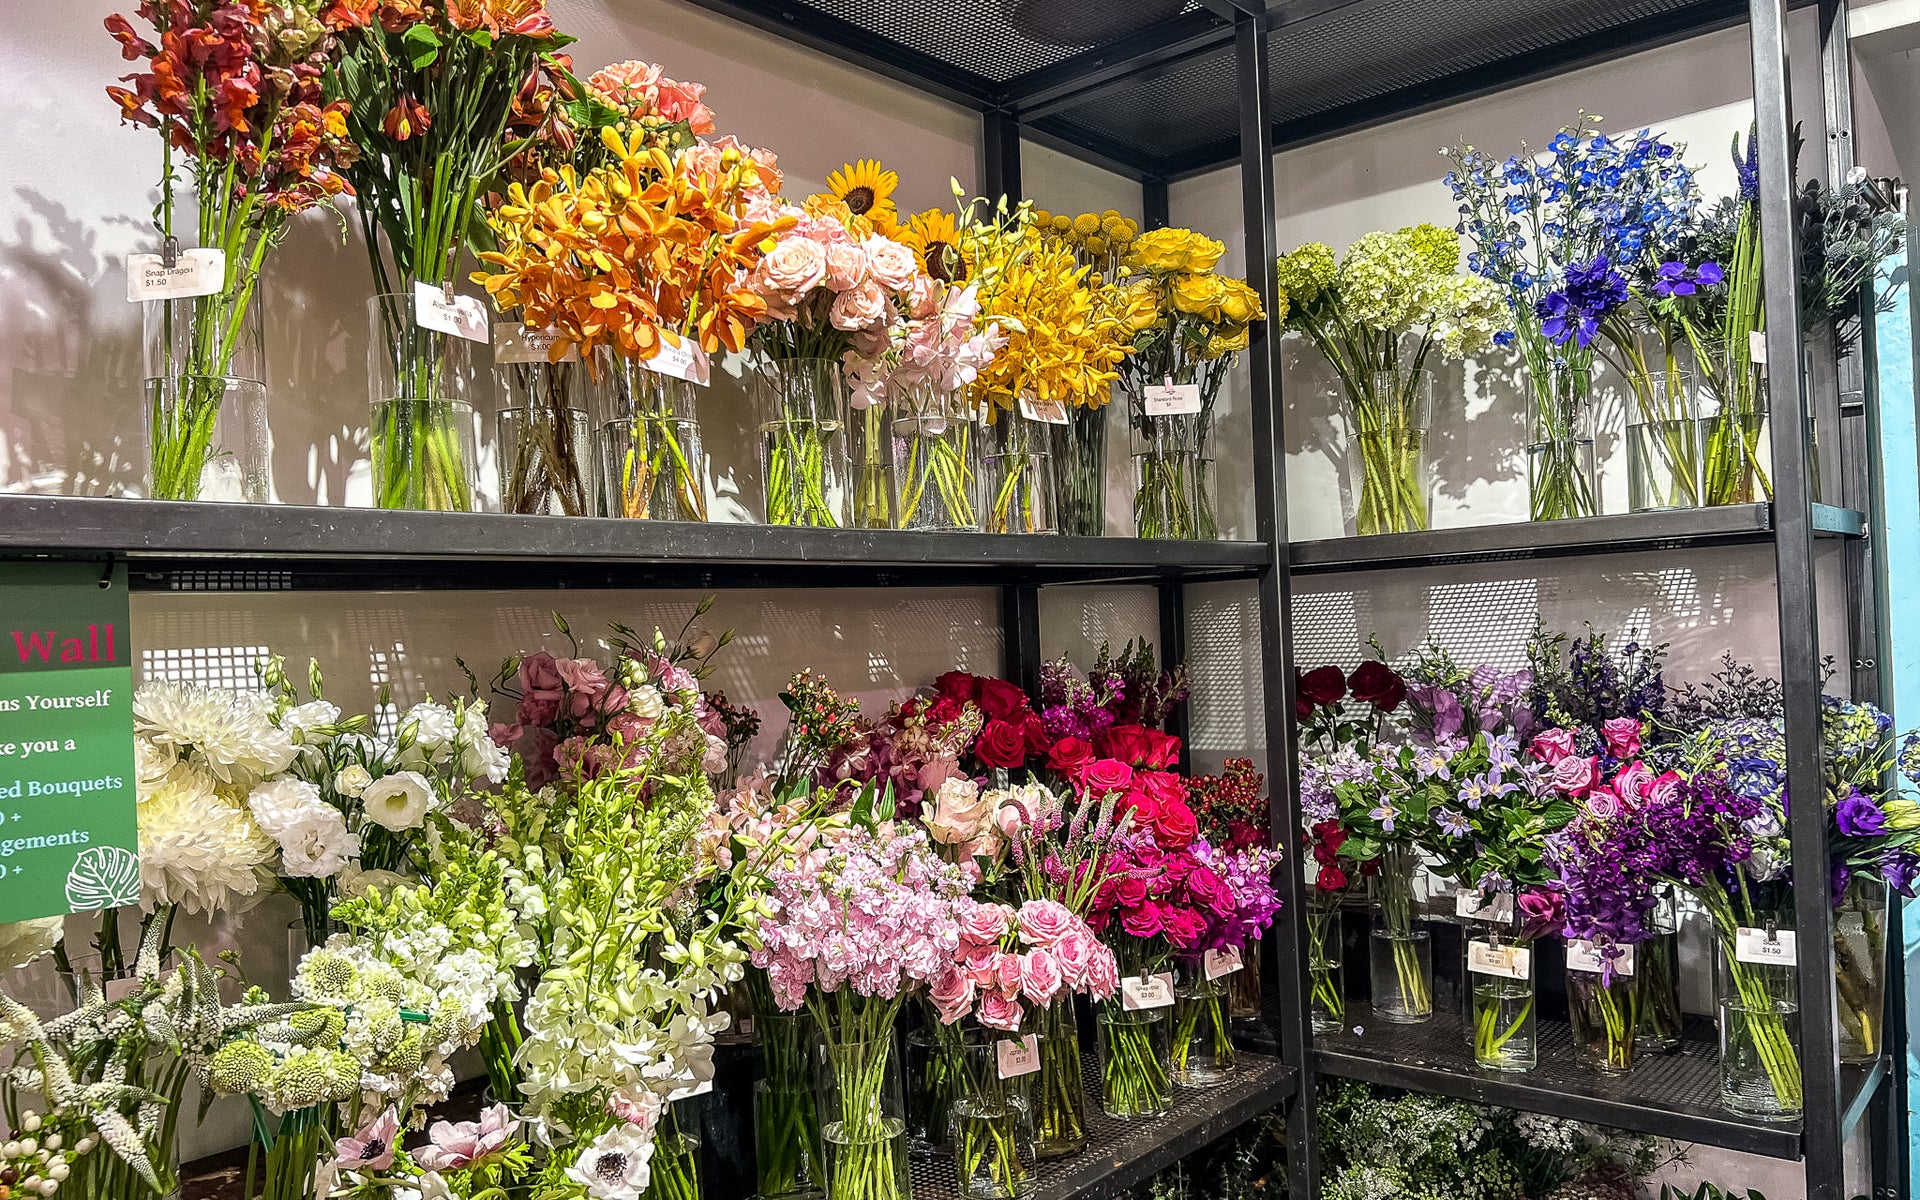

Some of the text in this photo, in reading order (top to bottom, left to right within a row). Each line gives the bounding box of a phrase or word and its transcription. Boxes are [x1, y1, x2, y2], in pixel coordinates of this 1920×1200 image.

[145, 266, 194, 279] Snap Dragon
[145, 278, 167, 287] $1.50
[11, 623, 117, 663] Wall
[25, 689, 112, 711] Yourself
[21, 739, 59, 759] you
[64, 739, 77, 750] a
[28, 775, 123, 798] Bouquets
[1762, 946, 1782, 955] $1.50
